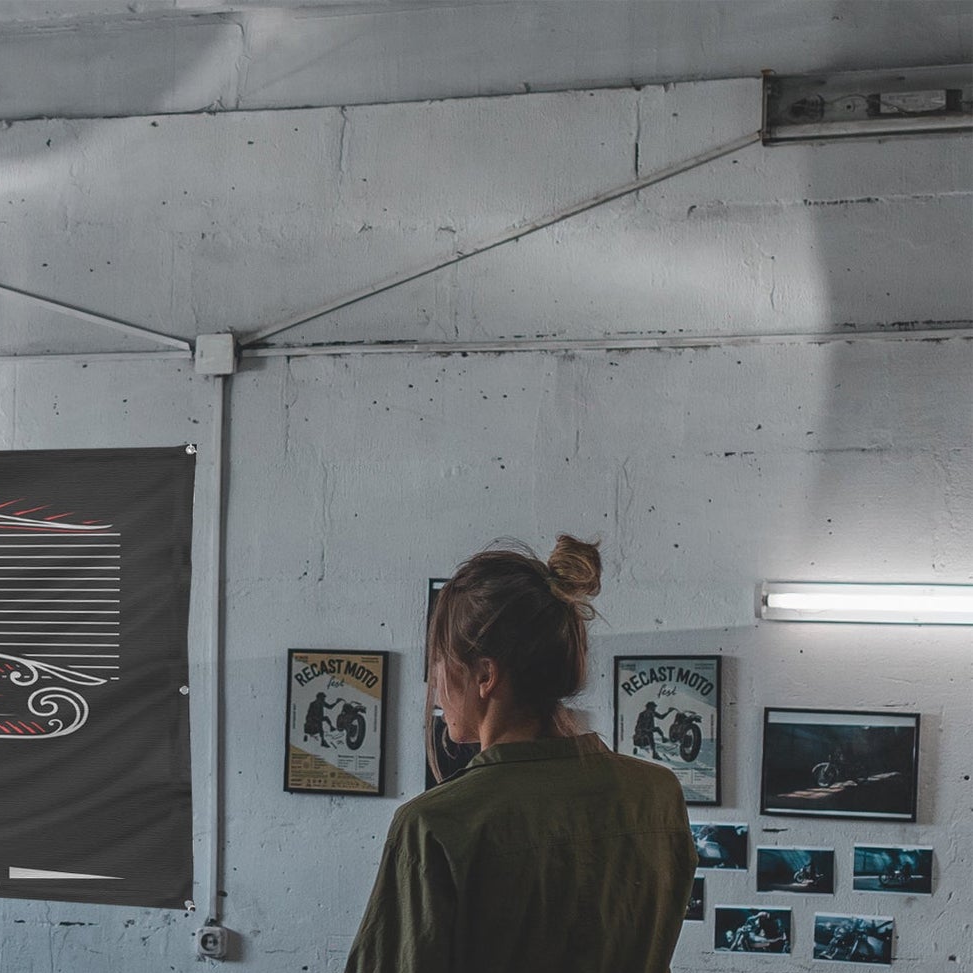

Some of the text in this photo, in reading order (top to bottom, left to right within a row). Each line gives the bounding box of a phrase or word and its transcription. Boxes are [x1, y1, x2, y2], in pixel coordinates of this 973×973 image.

[294, 659, 379, 689] RECAST MOTO
[327, 675, 344, 690] fest
[621, 666, 714, 696] RECAST MOTO
[657, 684, 677, 698] fest
